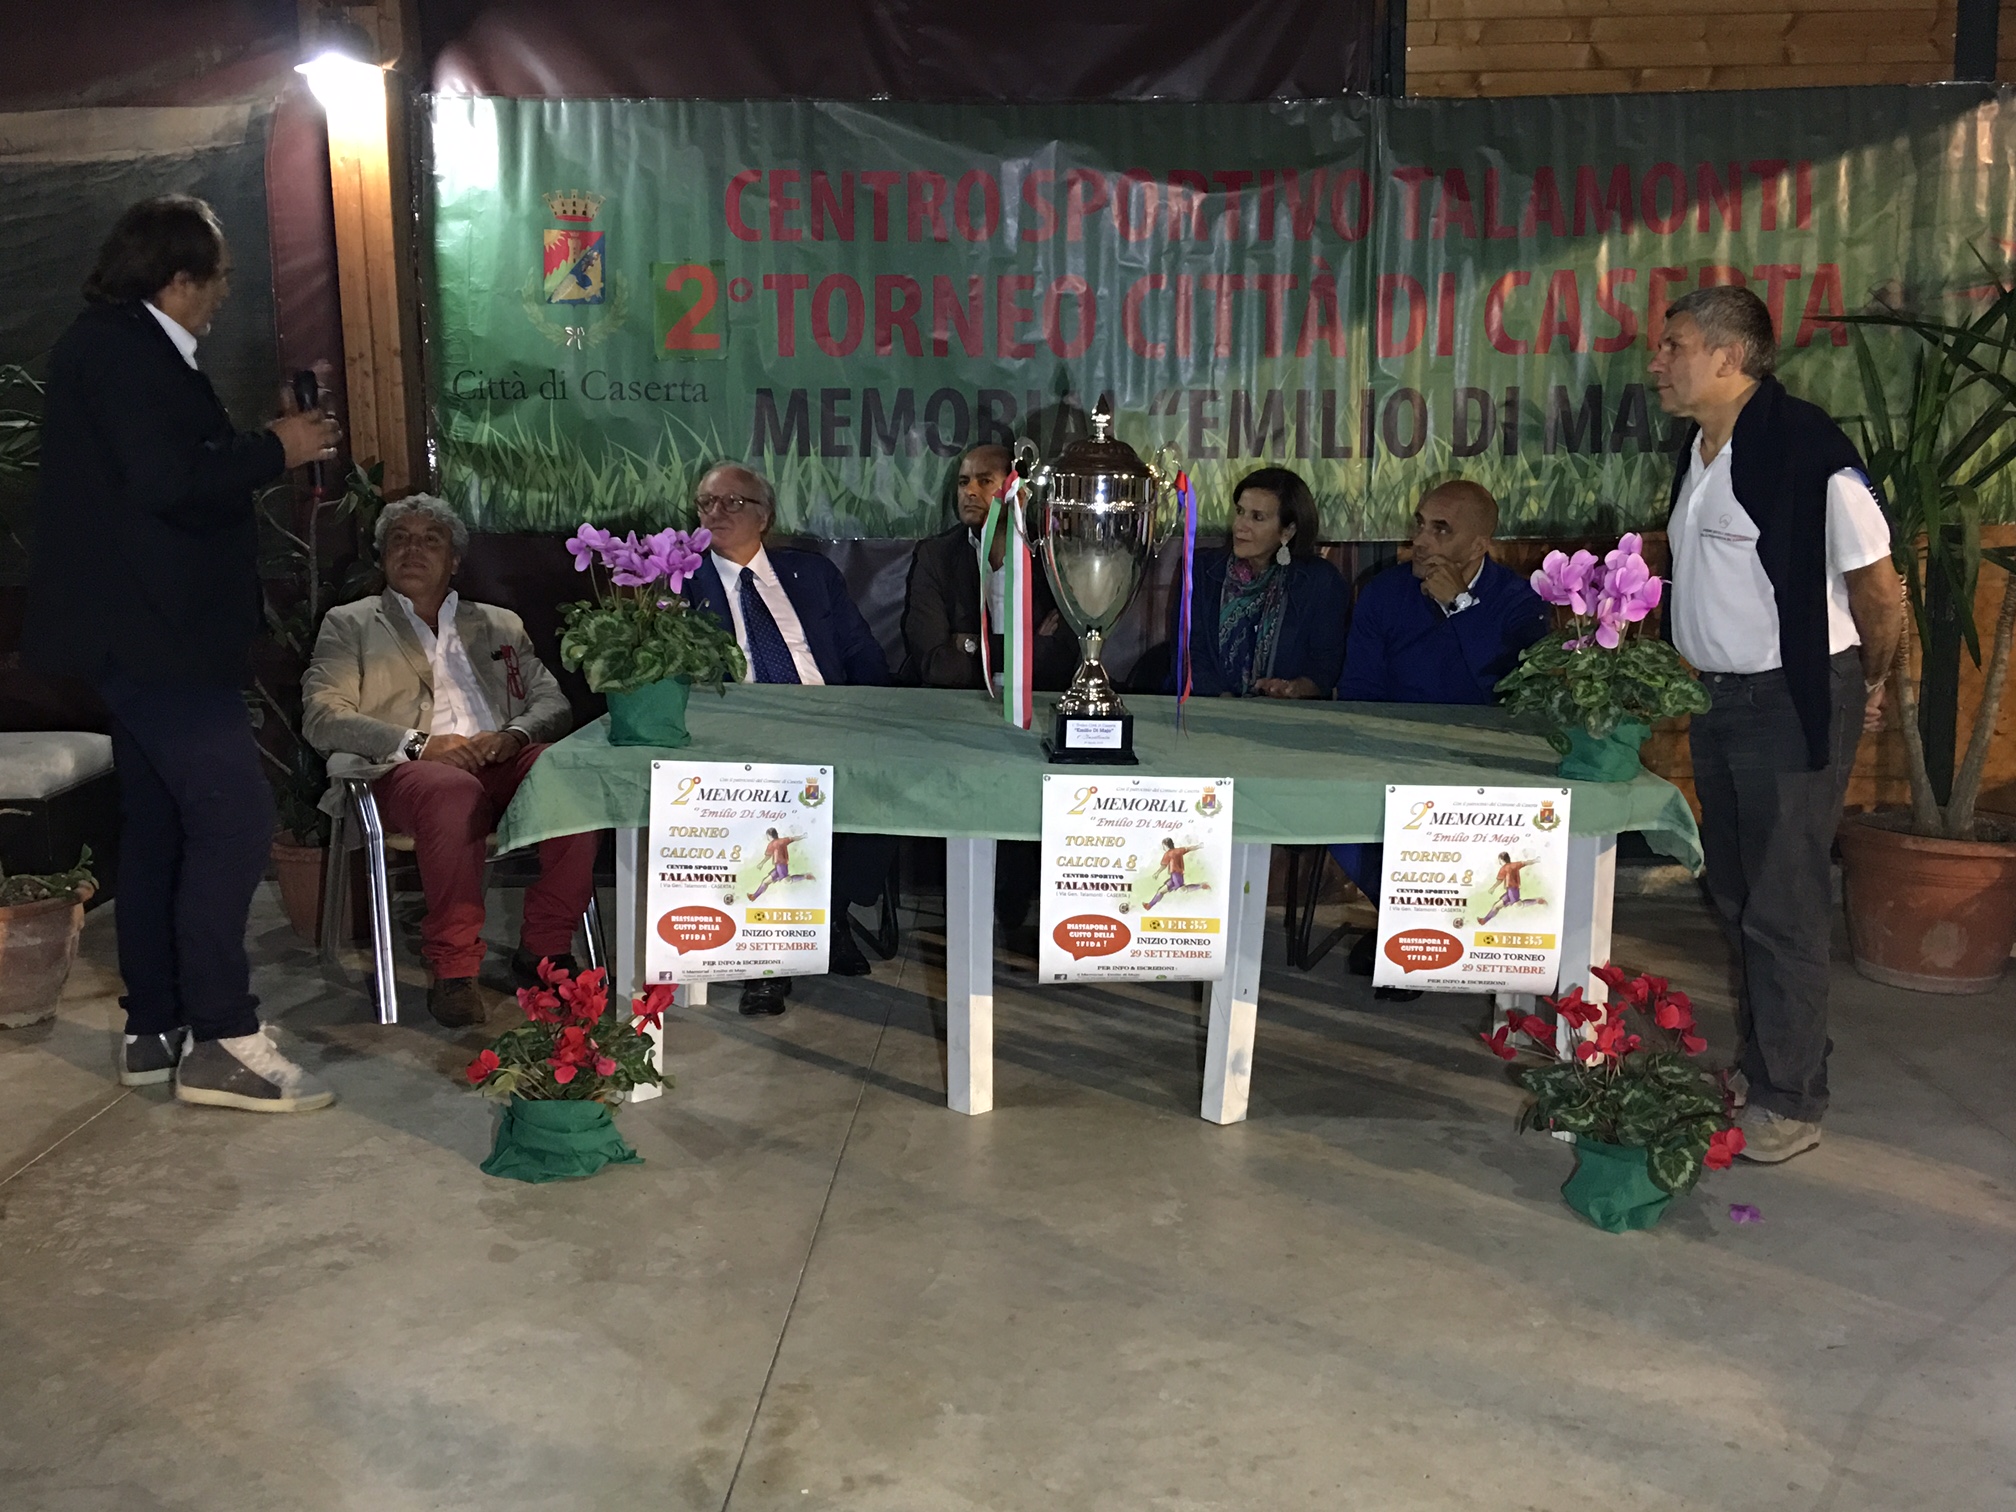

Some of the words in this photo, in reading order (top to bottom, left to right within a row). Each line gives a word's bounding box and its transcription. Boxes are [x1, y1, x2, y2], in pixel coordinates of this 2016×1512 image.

[724, 168, 1000, 243] CENTRO
[1022, 167, 1373, 243] SPORTIVO
[1393, 159, 1812, 240] TALAMONTI
[763, 273, 1096, 358] TORNEO
[1122, 256, 1346, 358] CITTÀ
[1376, 272, 1455, 358] DI
[1485, 263, 1848, 354] CASETA
[453, 370, 529, 401] Città
[538, 369, 569, 401] di
[580, 370, 709, 402] Caserta
[1452, 386, 1518, 458] DI
[696, 788, 791, 803] MEMORIAL
[1092, 797, 1188, 813] MEMORIAL
[739, 809, 754, 819] Di
[756, 810, 787, 822] Majo
[1429, 812, 1525, 827] MEMORIAL
[1136, 818, 1150, 828] Di
[1152, 819, 1183, 832] Majo
[668, 826, 730, 838] TORNEO
[1065, 835, 1126, 847] TORNEO
[1472, 833, 1487, 843] Di
[1489, 834, 1520, 846] Majo
[659, 846, 714, 859] CALCIO
[716, 848, 726, 859] A
[730, 844, 742, 862] 8
[1400, 851, 1462, 862] TORNEO
[1056, 856, 1110, 868] CALCIO
[1112, 857, 1122, 868] A
[1125, 854, 1138, 871] 8
[659, 872, 737, 883] TALAMONTI
[1390, 871, 1445, 883] CALCIO
[1447, 873, 1458, 883] A
[1460, 869, 1474, 886] 8
[1055, 881, 1133, 892] TALAMONTI
[1389, 896, 1467, 907] TALAMONTI
[795, 911, 812, 921] 35
[1190, 920, 1207, 930] 35
[742, 929, 773, 937] INIZIO
[774, 929, 816, 938] TORNEO
[735, 943, 747, 951] 29
[749, 942, 818, 951] SETTEMBRE
[1136, 937, 1167, 945] INIZIO
[1169, 938, 1211, 946] TORNEO
[1524, 935, 1543, 946] 35
[1130, 949, 1142, 958] 29
[1144, 949, 1212, 959] SETTEMBRE
[1469, 951, 1501, 960] INIZIO
[1503, 952, 1545, 962] TORNEO
[1462, 964, 1474, 972] 29
[1476, 964, 1546, 974] SETTEMBRE
